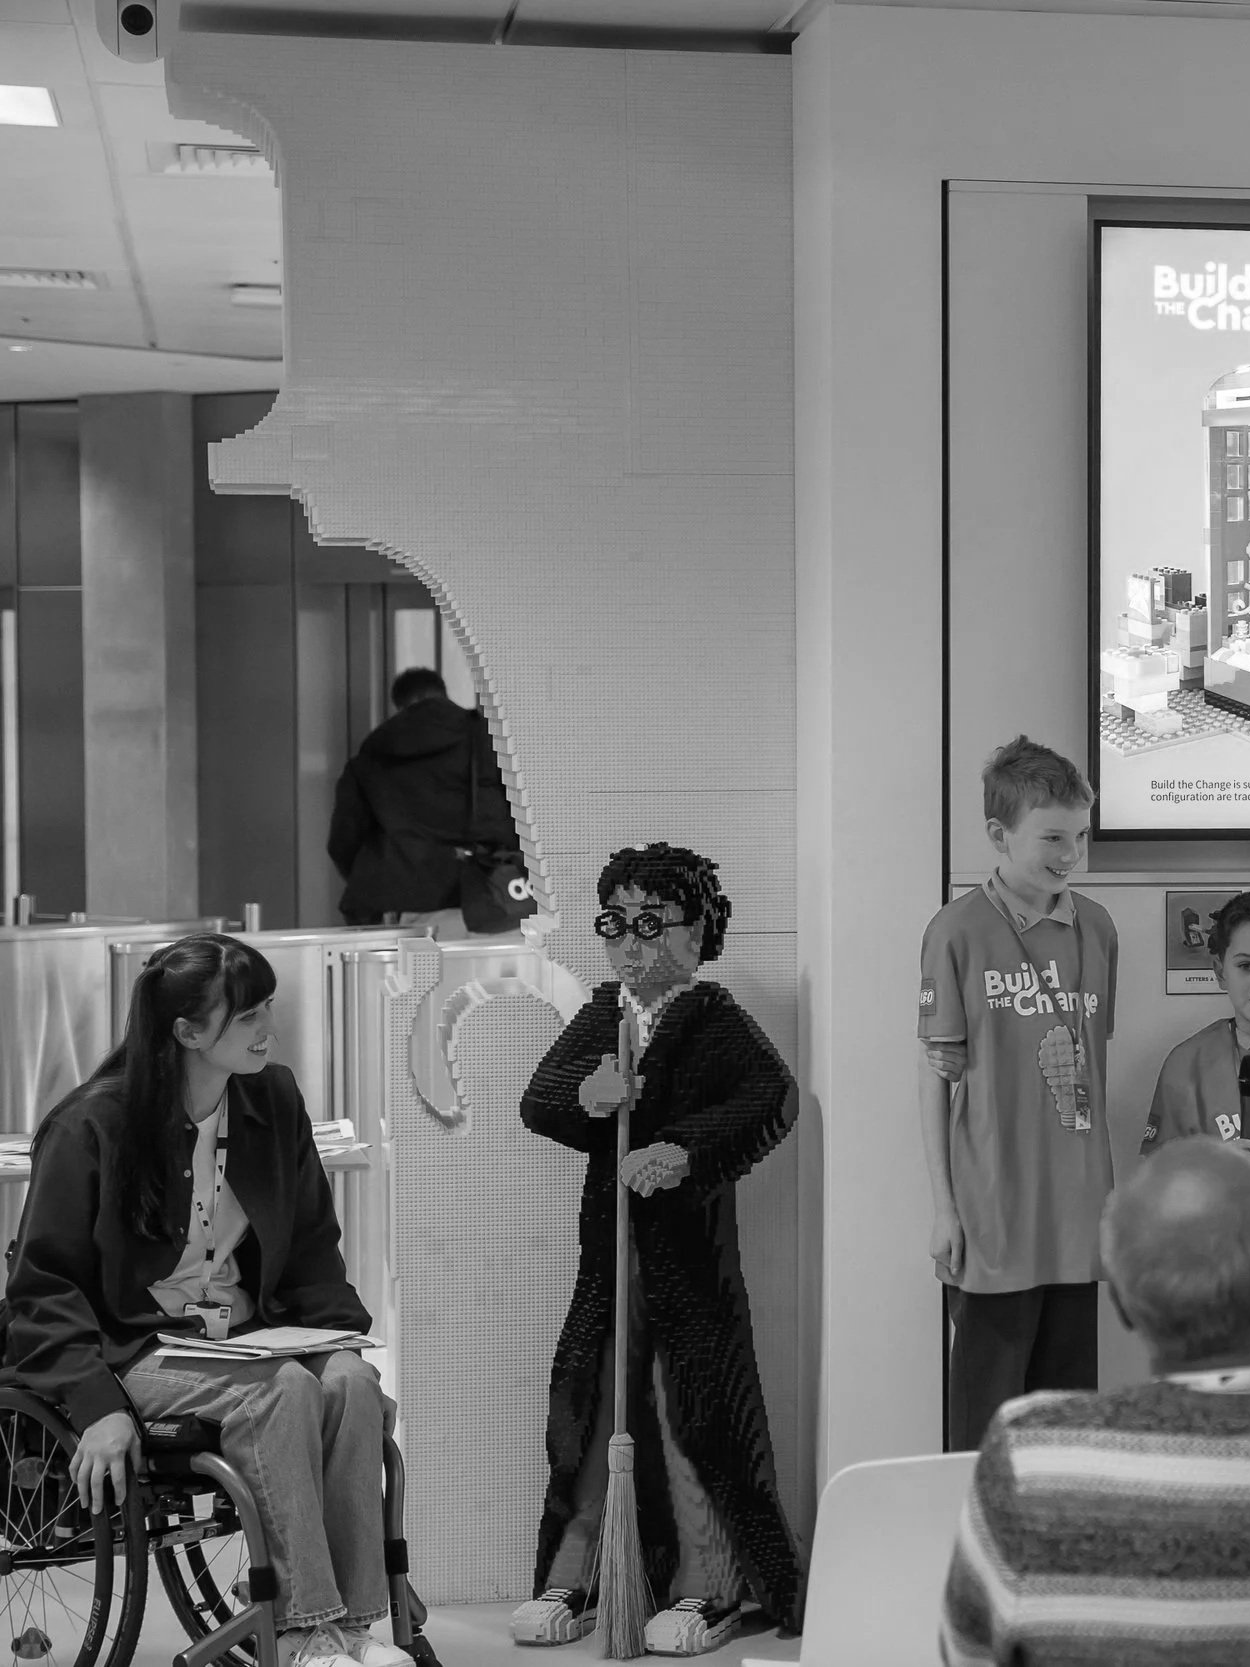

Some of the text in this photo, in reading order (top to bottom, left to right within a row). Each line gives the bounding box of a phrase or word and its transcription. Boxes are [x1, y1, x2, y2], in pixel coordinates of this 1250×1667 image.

[1154, 301, 1185, 315] THE
[1151, 780, 1175, 789] Build
[1178, 780, 1193, 789] the
[1195, 780, 1231, 791] Change
[1234, 780, 1241, 789] is
[1150, 792, 1214, 803] configuration
[1216, 793, 1232, 801] are
[984, 960, 1060, 996] Build
[987, 997, 1012, 1009] THE
